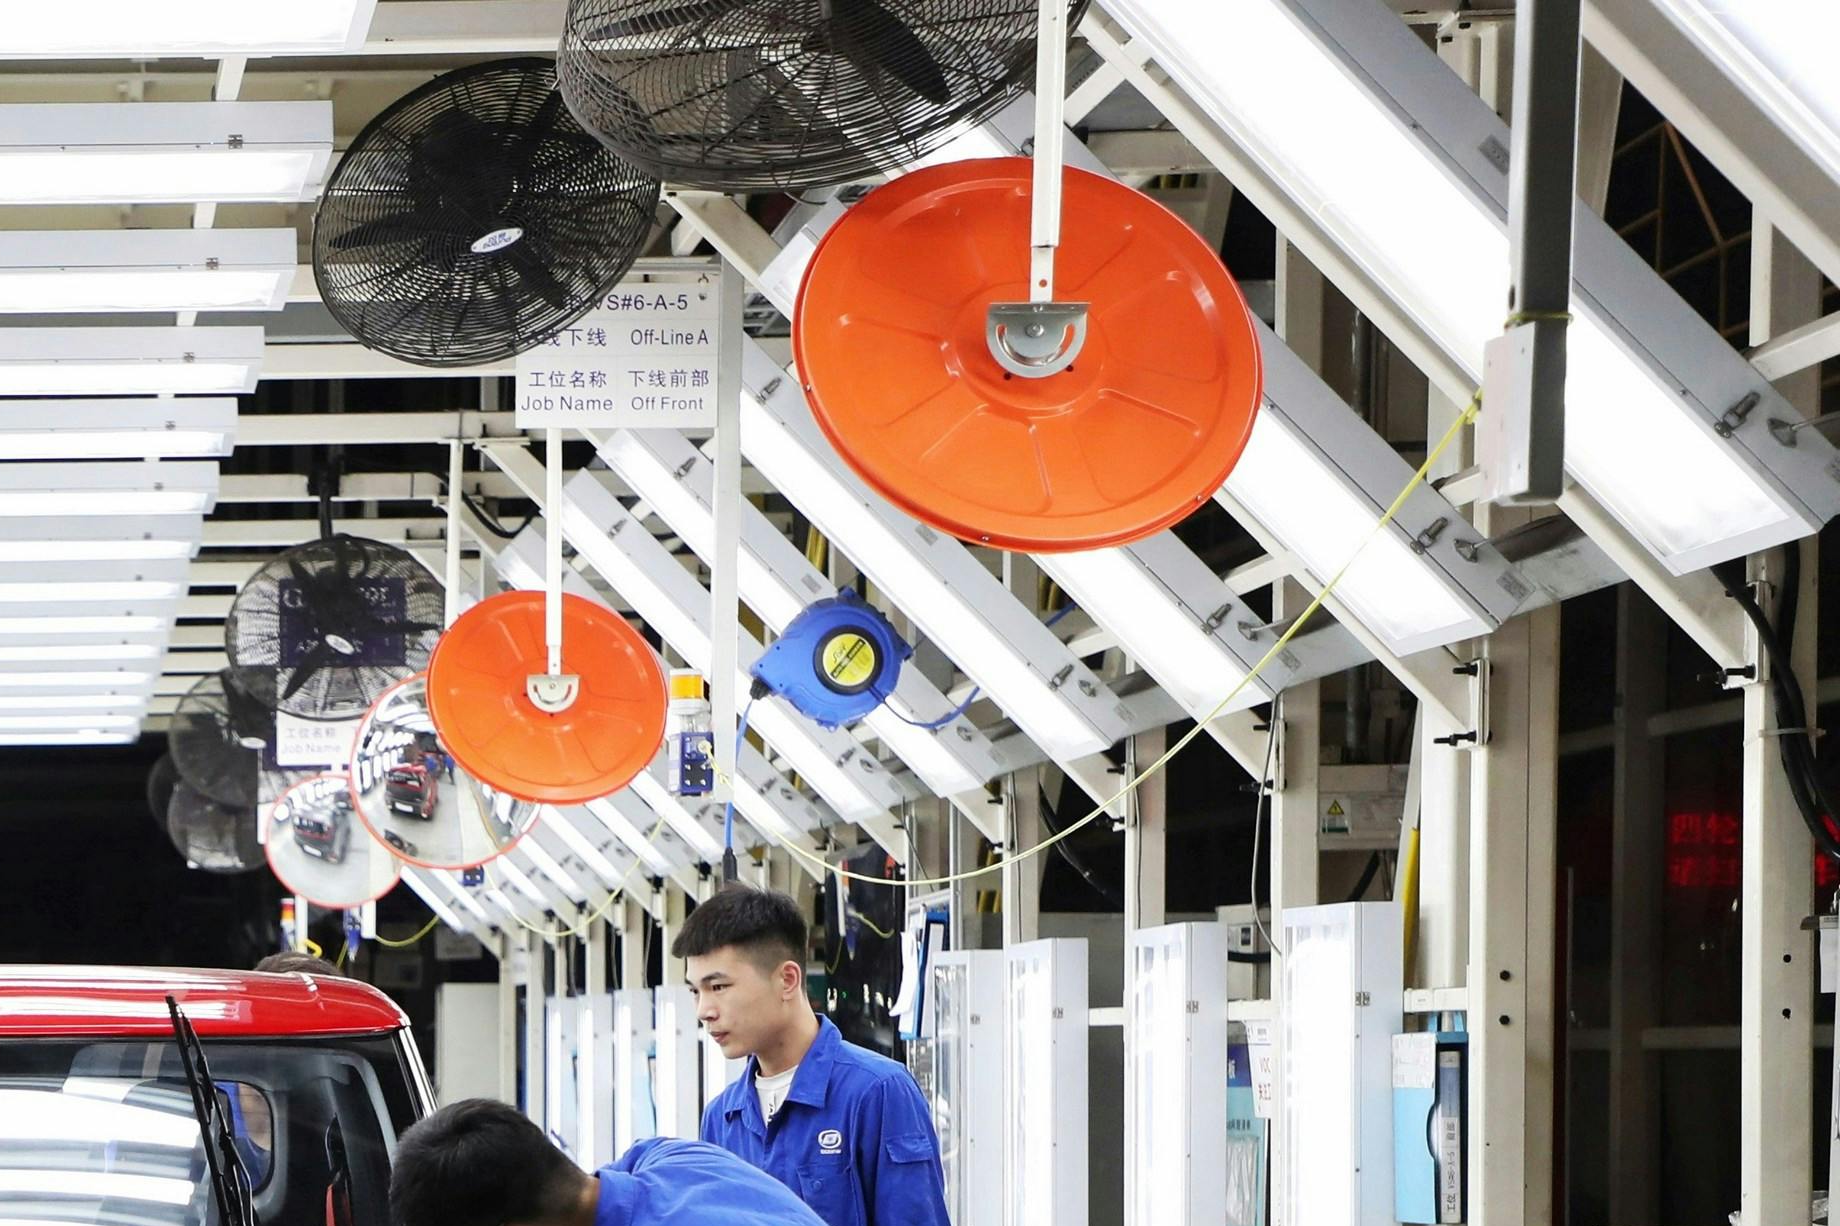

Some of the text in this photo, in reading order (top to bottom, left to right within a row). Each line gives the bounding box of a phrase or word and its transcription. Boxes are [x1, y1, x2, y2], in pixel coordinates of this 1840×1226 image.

[630, 328, 709, 345] Off-Line A
[528, 369, 710, 388] 工位名称 下线前部
[521, 396, 704, 411] Job Name Off Front
[285, 727, 336, 738] 工位名称
